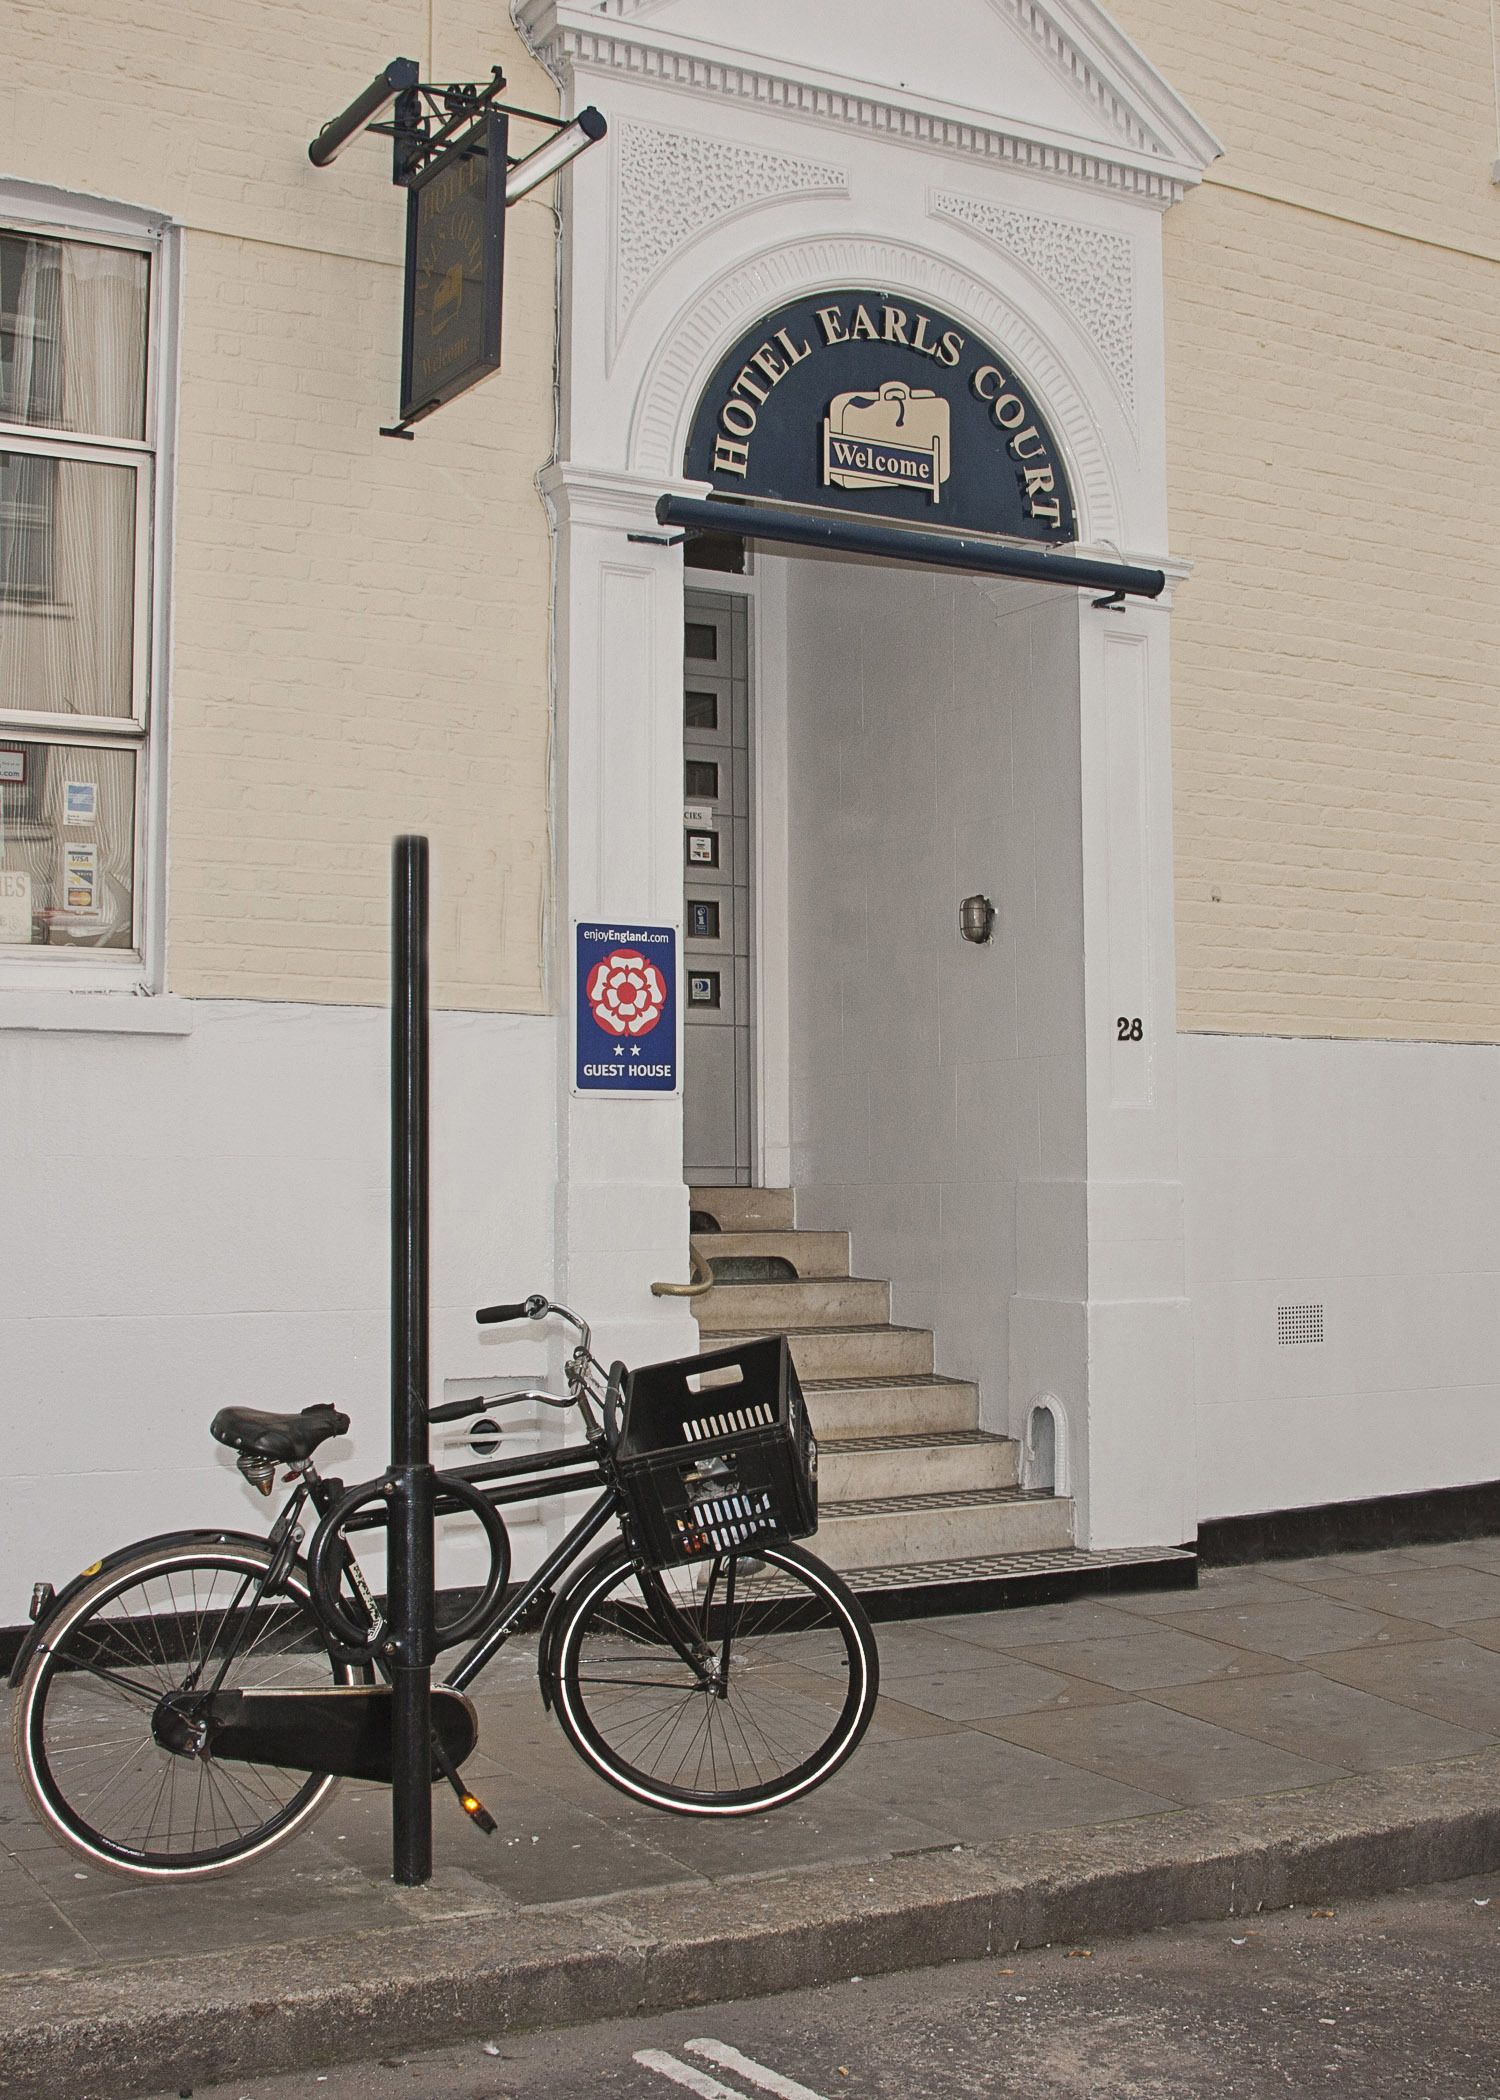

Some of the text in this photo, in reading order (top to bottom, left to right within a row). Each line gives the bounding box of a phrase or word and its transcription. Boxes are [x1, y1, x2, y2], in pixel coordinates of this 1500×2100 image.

[713, 304, 1061, 529] HOTEL EARLS COURT
[832, 441, 930, 479] Welcome
[584, 928, 669, 943] enjoyEngland.com
[1117, 1016, 1143, 1042] 28
[583, 1064, 672, 1077] GUEST HOUSE
